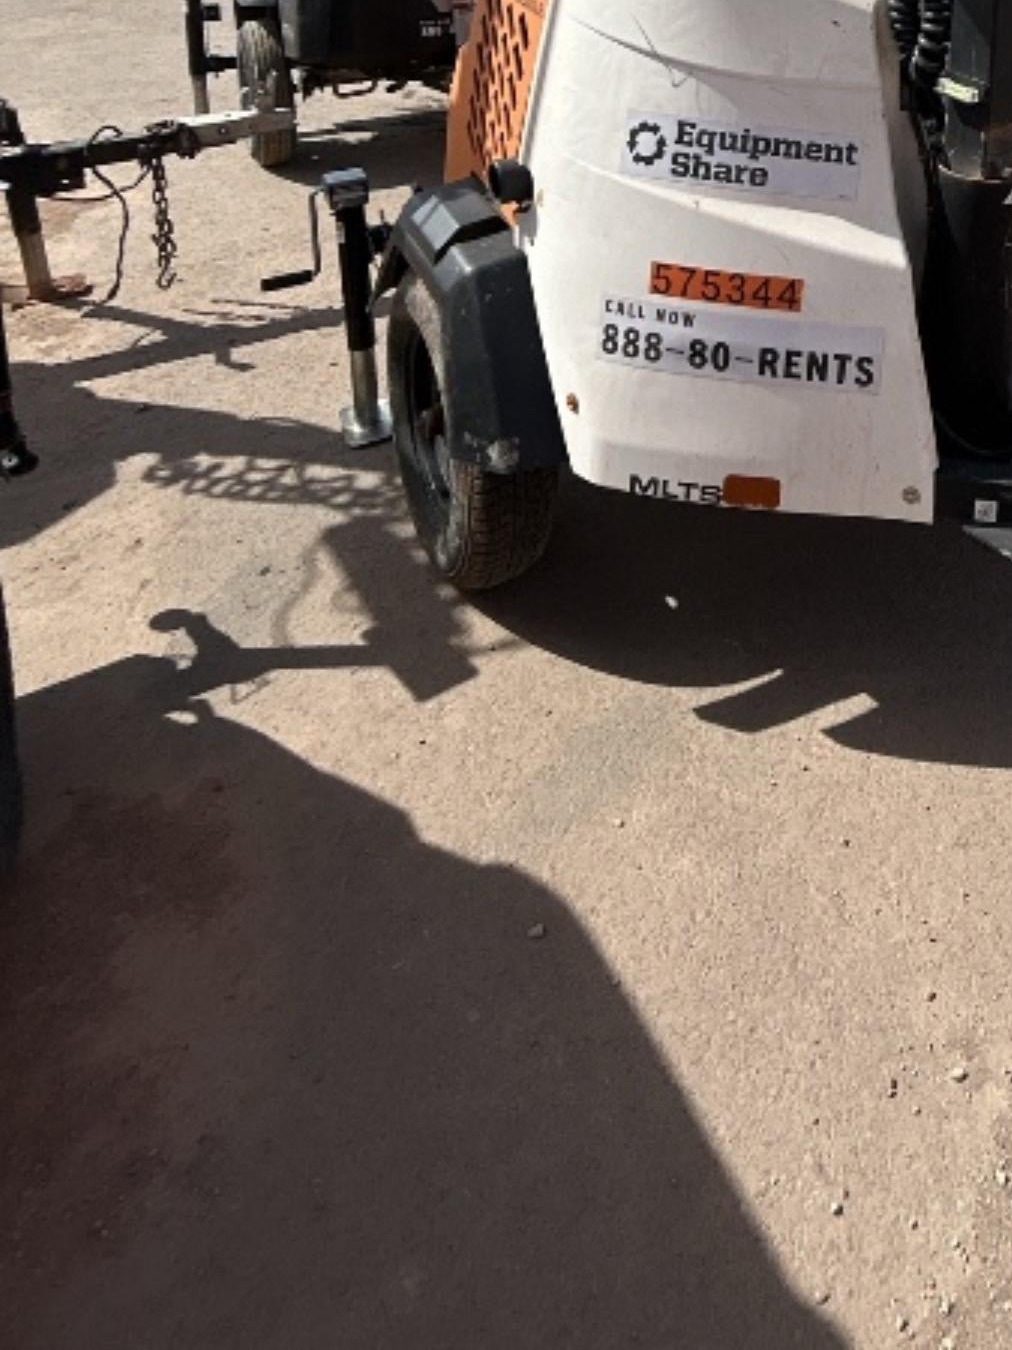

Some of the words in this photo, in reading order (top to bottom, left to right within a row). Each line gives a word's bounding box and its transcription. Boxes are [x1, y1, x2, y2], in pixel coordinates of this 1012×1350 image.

[674, 120, 858, 165] Equipment
[671, 152, 769, 187] Share
[652, 263, 801, 310] 575344
[604, 299, 647, 319] CALL
[656, 309, 697, 328] NOW
[602, 323, 874, 388] 888-80-RENTS
